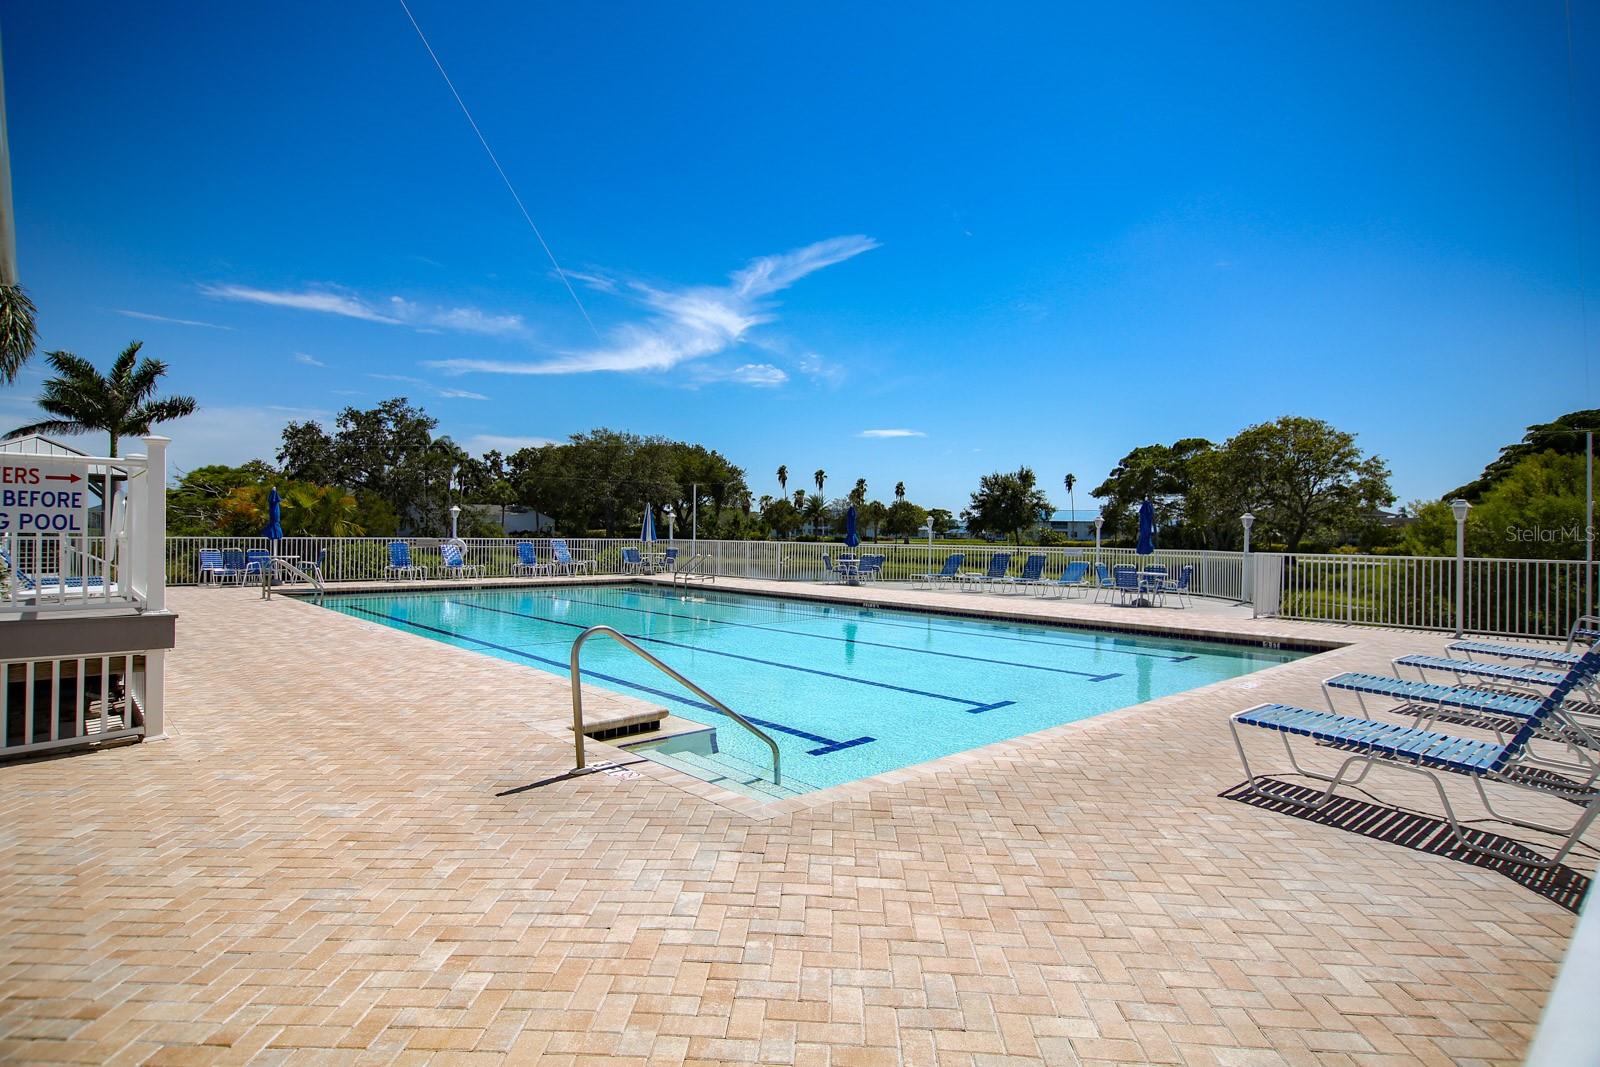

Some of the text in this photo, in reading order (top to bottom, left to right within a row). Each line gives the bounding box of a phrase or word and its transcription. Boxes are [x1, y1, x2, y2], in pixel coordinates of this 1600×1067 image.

[0, 466, 40, 485] ERS
[3, 489, 82, 509] BEFORE
[19, 513, 81, 531] POOL
